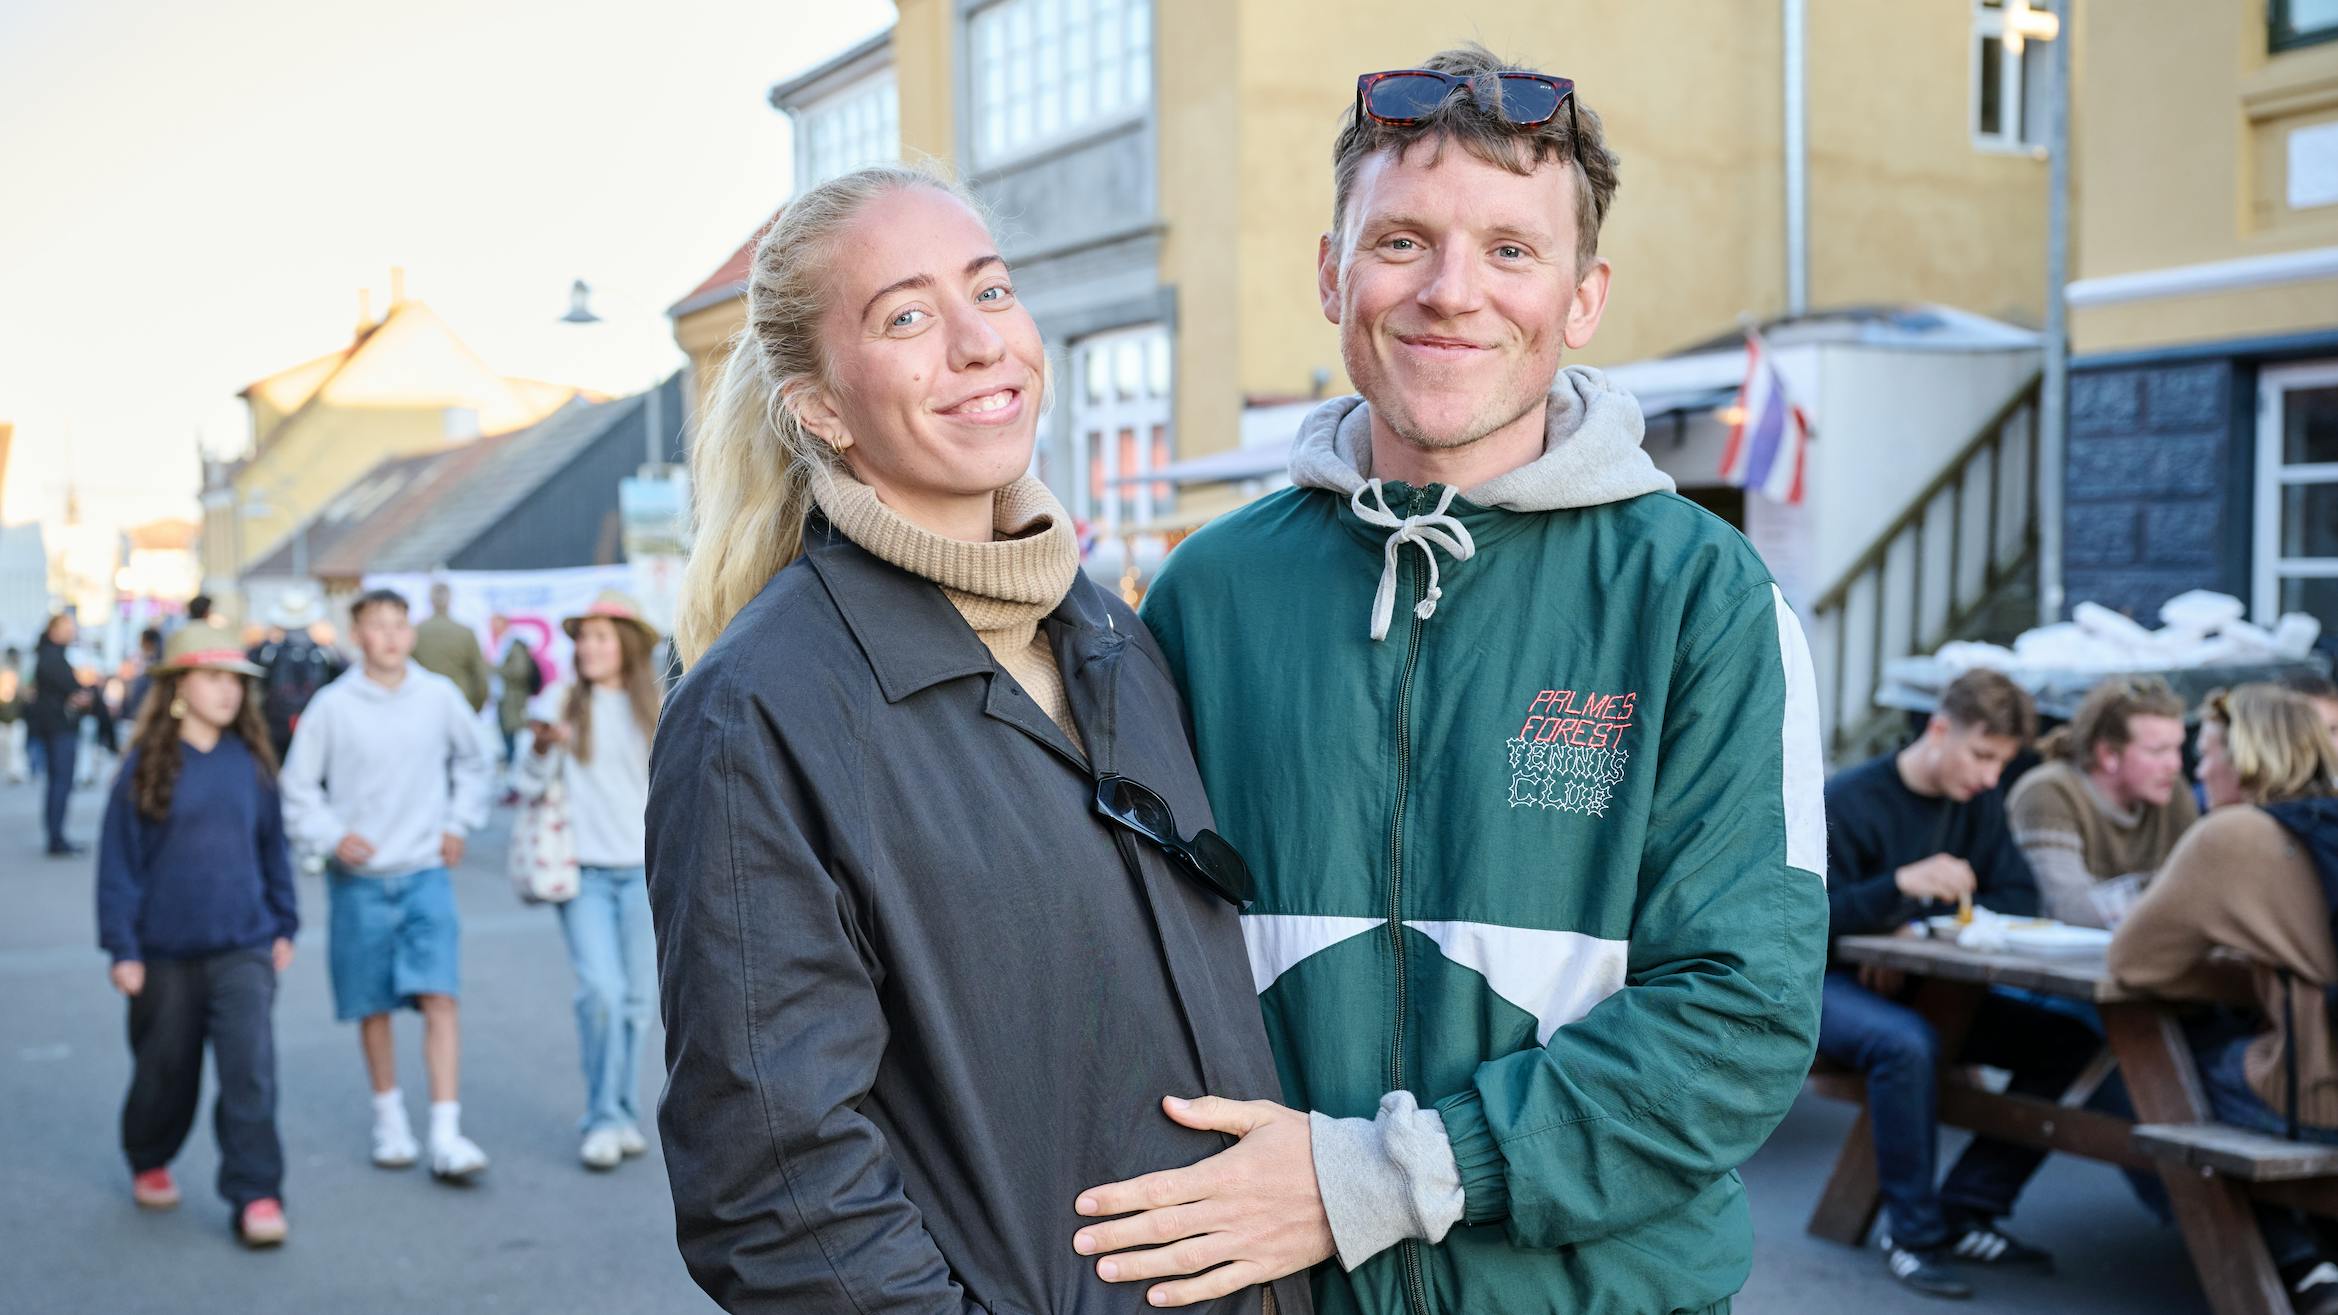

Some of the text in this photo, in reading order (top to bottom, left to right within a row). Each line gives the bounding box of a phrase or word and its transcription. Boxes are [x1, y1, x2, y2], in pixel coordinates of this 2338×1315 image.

[1528, 690, 1637, 720] PALMES
[1520, 715, 1632, 750] FOREST
[1506, 737, 1629, 785] TENNIS
[1508, 770, 1613, 818] CLUB
